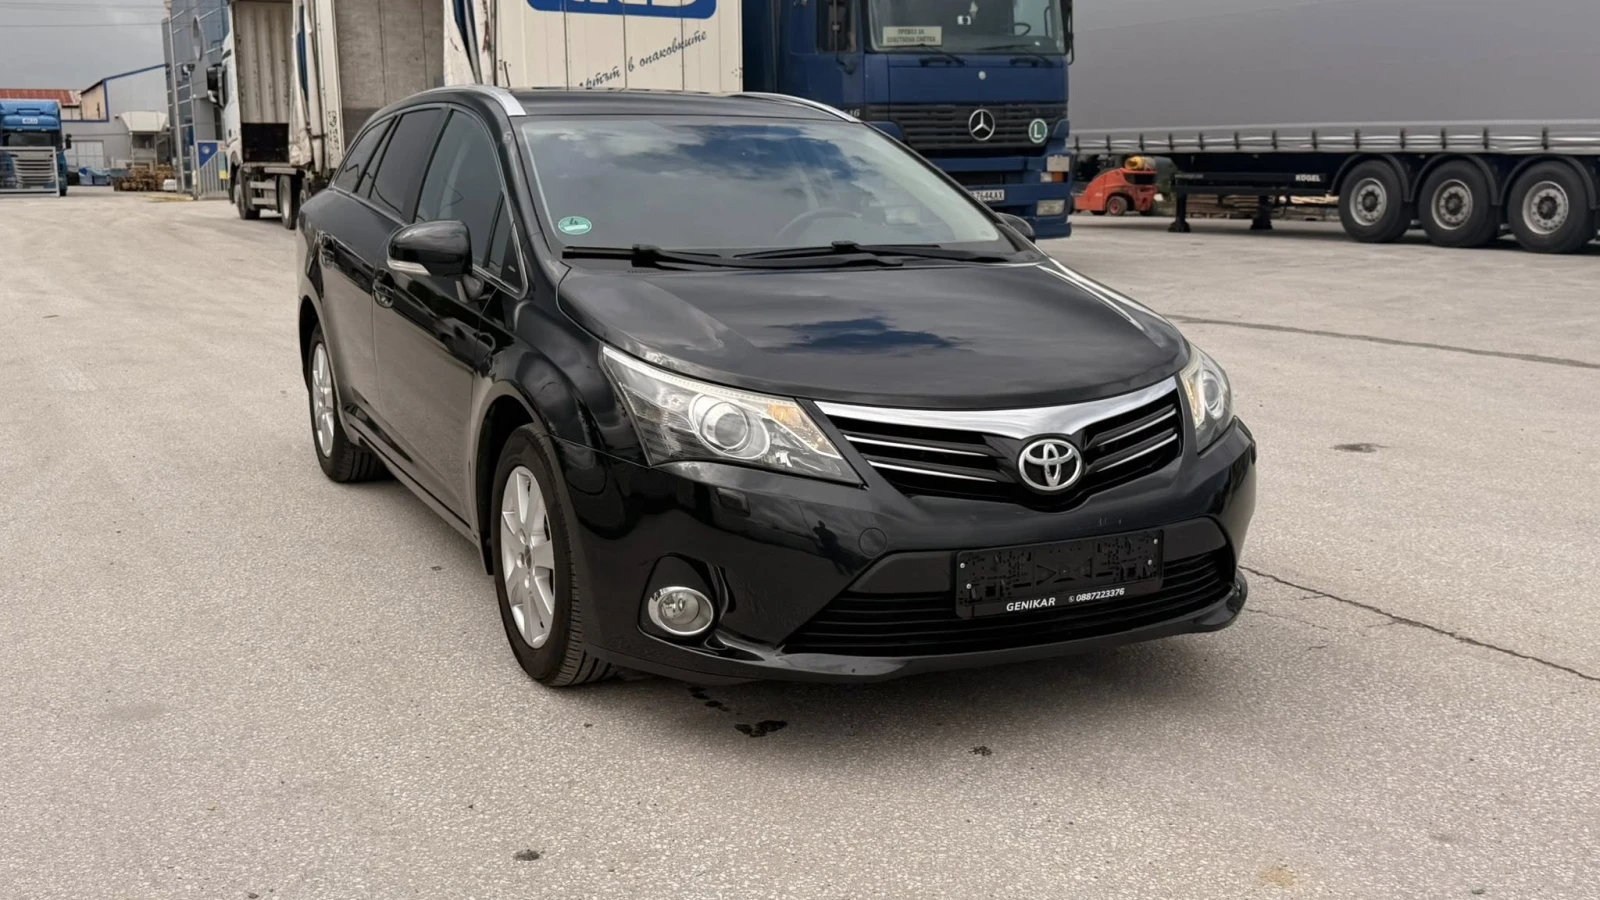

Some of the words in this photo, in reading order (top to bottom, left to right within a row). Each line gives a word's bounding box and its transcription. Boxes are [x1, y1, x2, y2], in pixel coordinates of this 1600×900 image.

[1034, 124, 1042, 138] L
[1006, 597, 1056, 612] GENIKAR
[1076, 587, 1125, 602] 0887223376
